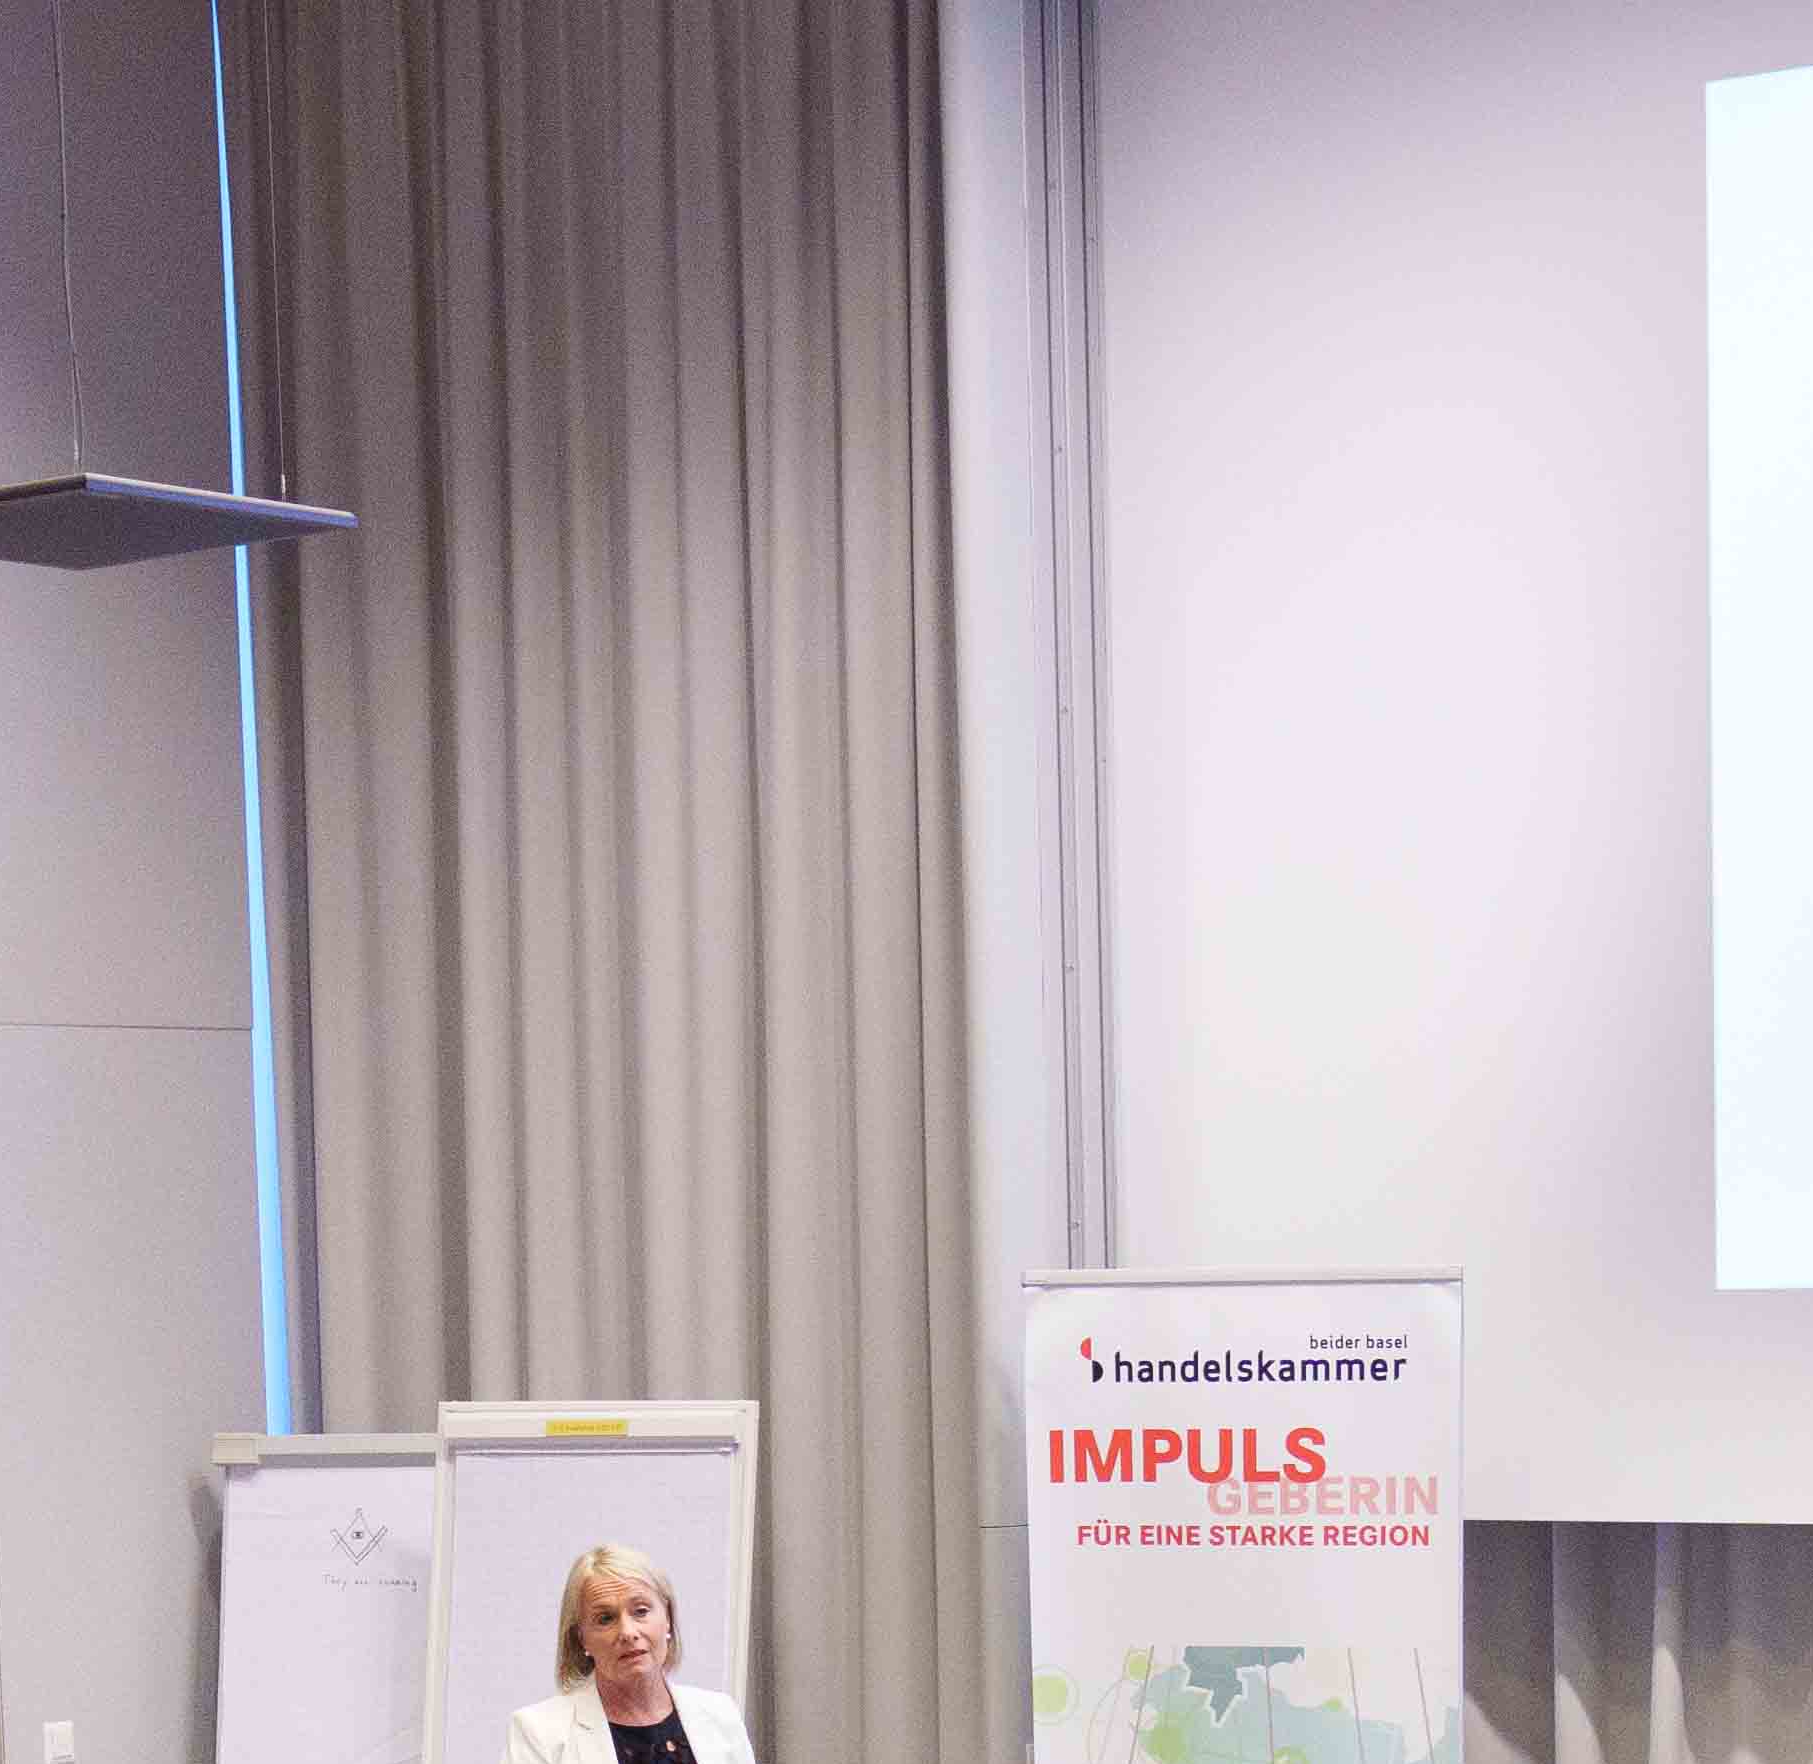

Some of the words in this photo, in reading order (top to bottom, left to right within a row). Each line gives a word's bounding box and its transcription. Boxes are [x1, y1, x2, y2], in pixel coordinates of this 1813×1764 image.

[1309, 1335, 1361, 1350] beider
[1366, 1334, 1408, 1349] basel
[1114, 1349, 1406, 1384] handelskammer
[1049, 1427, 1327, 1484] IMPULS
[1207, 1476, 1439, 1516] GEBERIN
[1077, 1519, 1131, 1547] FÜR
[1140, 1526, 1201, 1547] EINE
[1209, 1524, 1314, 1547] STARKE
[1323, 1524, 1430, 1547] REGION
